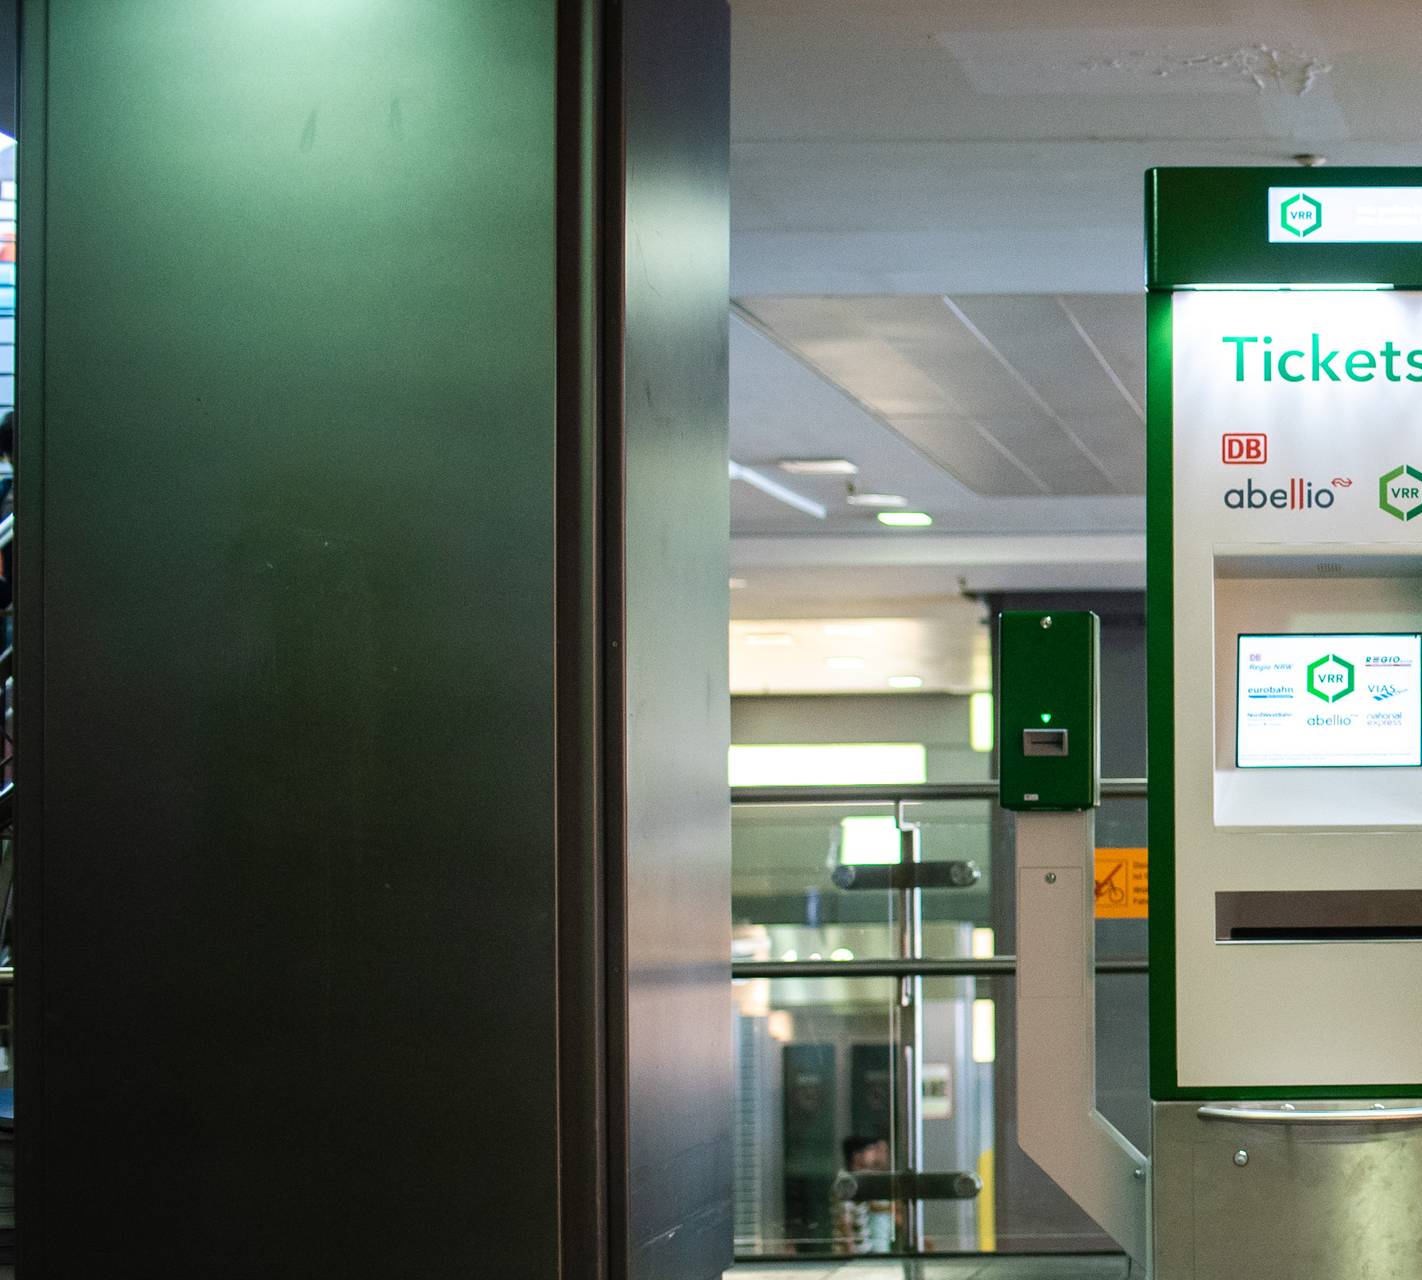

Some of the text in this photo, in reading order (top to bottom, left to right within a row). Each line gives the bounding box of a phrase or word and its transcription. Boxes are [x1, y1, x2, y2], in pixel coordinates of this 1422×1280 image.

[1290, 210, 1312, 220] VRR
[1228, 440, 1261, 460] DB
[1223, 479, 1334, 511] abellio
[1391, 486, 1420, 500] VRR
[1318, 674, 1344, 683] VRR
[1247, 685, 1294, 694] eurobahn
[1368, 684, 1396, 693] VIAS
[1307, 713, 1352, 726] abellio
[1366, 712, 1402, 720] national
